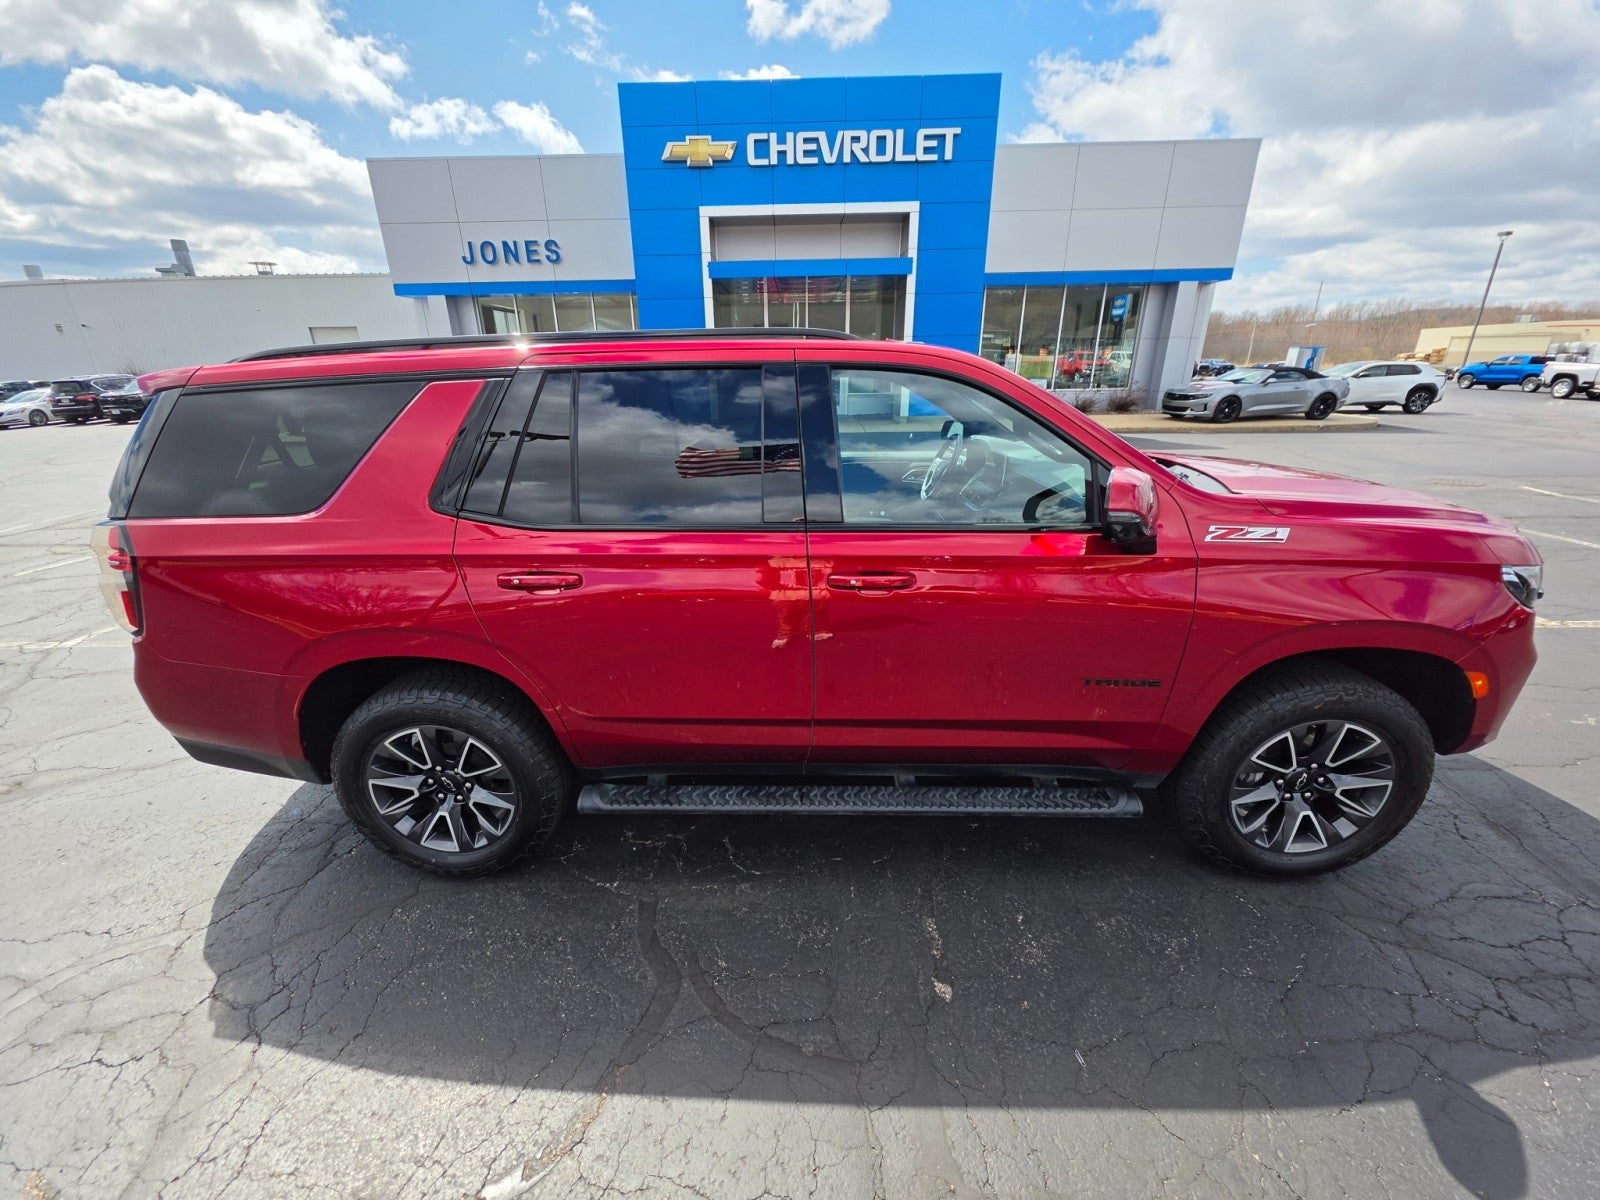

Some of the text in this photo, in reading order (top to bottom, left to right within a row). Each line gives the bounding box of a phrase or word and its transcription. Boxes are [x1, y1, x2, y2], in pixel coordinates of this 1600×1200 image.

[747, 127, 961, 166] CHEVROLET
[461, 239, 562, 266] JONES
[1204, 525, 1291, 543] Z71
[1081, 676, 1162, 688] TAHOE
